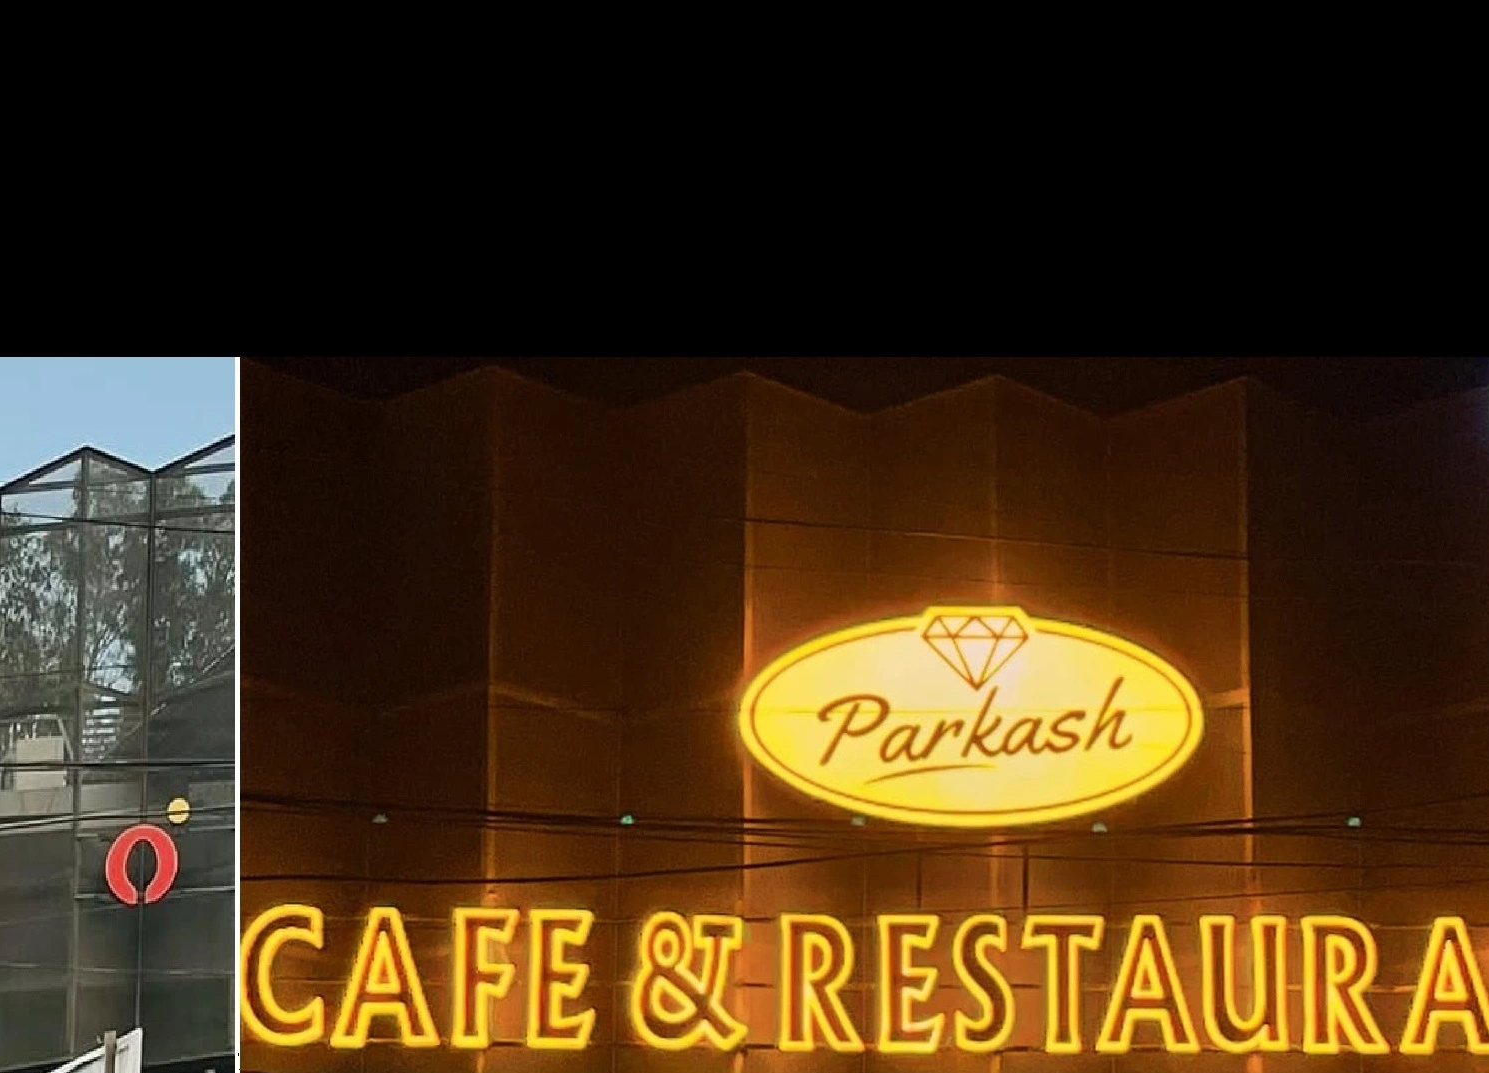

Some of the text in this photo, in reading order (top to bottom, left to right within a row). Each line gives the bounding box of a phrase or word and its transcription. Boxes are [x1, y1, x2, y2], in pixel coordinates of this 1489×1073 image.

[817, 674, 1133, 768] Parkash
[240, 904, 596, 1049] CAFE
[631, 911, 747, 1051] &
